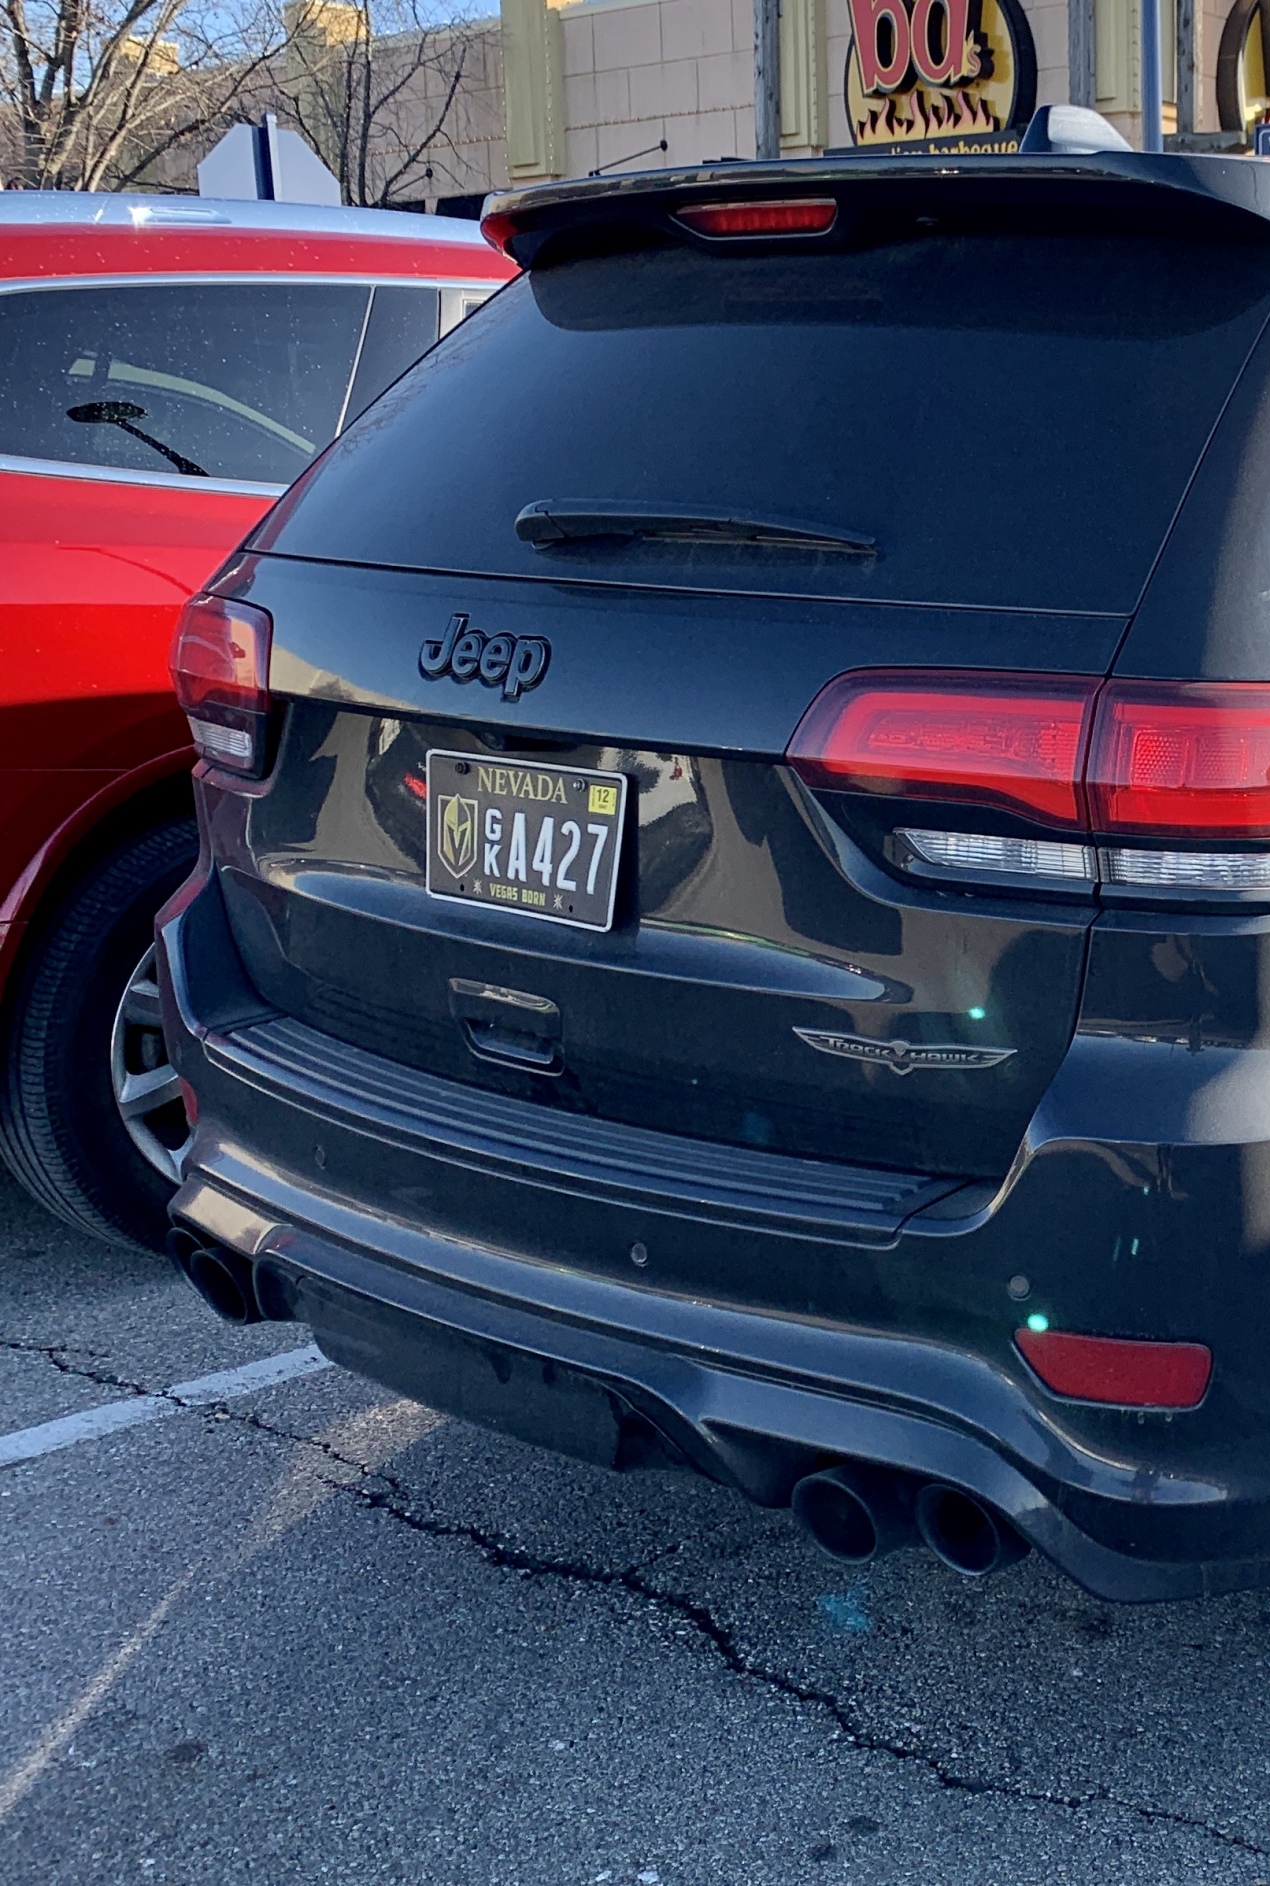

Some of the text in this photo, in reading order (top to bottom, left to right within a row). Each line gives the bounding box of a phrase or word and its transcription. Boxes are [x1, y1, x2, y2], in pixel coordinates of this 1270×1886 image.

[418, 612, 552, 702] Jeep
[477, 767, 568, 805] NEVADA
[597, 788, 610, 803] 12
[489, 882, 546, 907] VEGAS BORN
